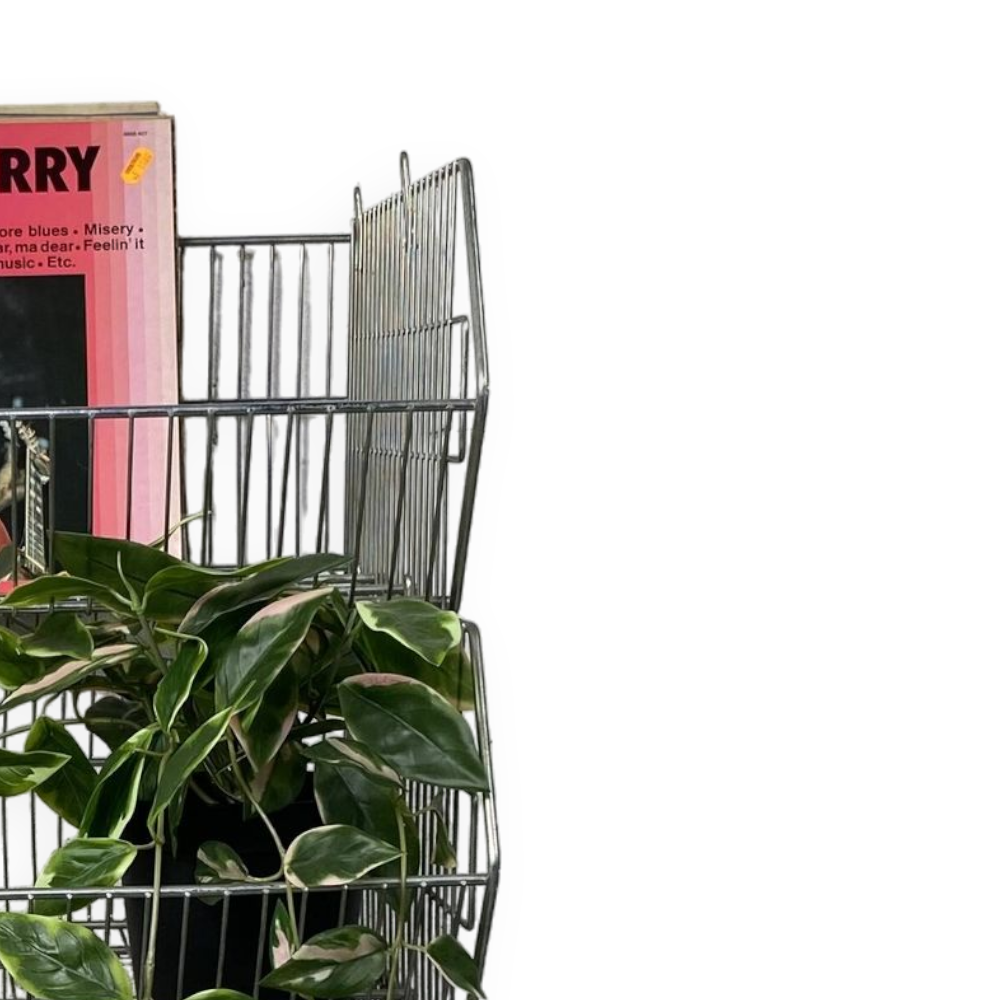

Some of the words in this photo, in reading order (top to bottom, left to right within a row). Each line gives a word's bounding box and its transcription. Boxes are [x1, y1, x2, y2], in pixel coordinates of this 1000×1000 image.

[29, 225, 68, 237] blues
[84, 224, 133, 238] Misery
[15, 244, 38, 253] ma
[41, 241, 74, 253] dear
[83, 238, 132, 251] Feelin'
[135, 237, 144, 250] it
[47, 256, 76, 268] Etc.
